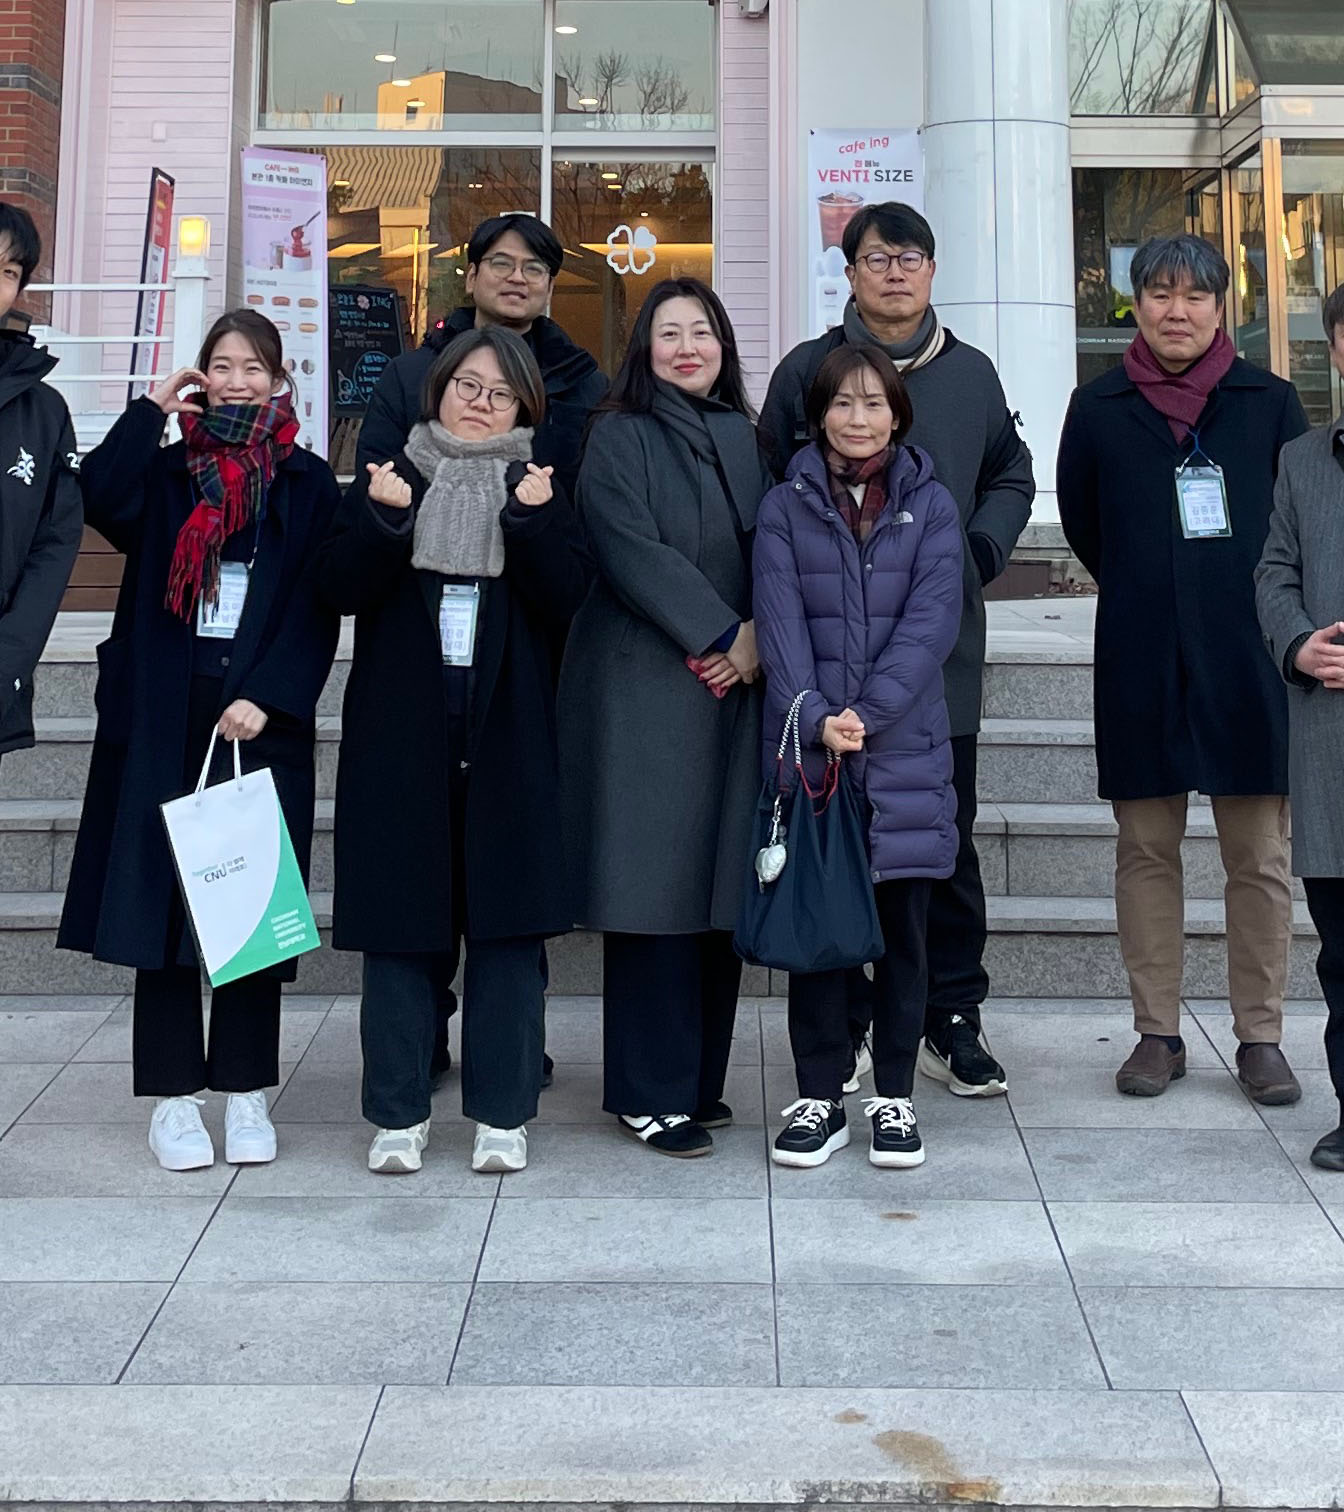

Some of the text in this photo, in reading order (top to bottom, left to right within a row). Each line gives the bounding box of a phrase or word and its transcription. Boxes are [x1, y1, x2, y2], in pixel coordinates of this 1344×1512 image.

[838, 136, 890, 154] cafe ing
[816, 169, 914, 183] VENTI SIZE
[204, 862, 227, 883] CNU
